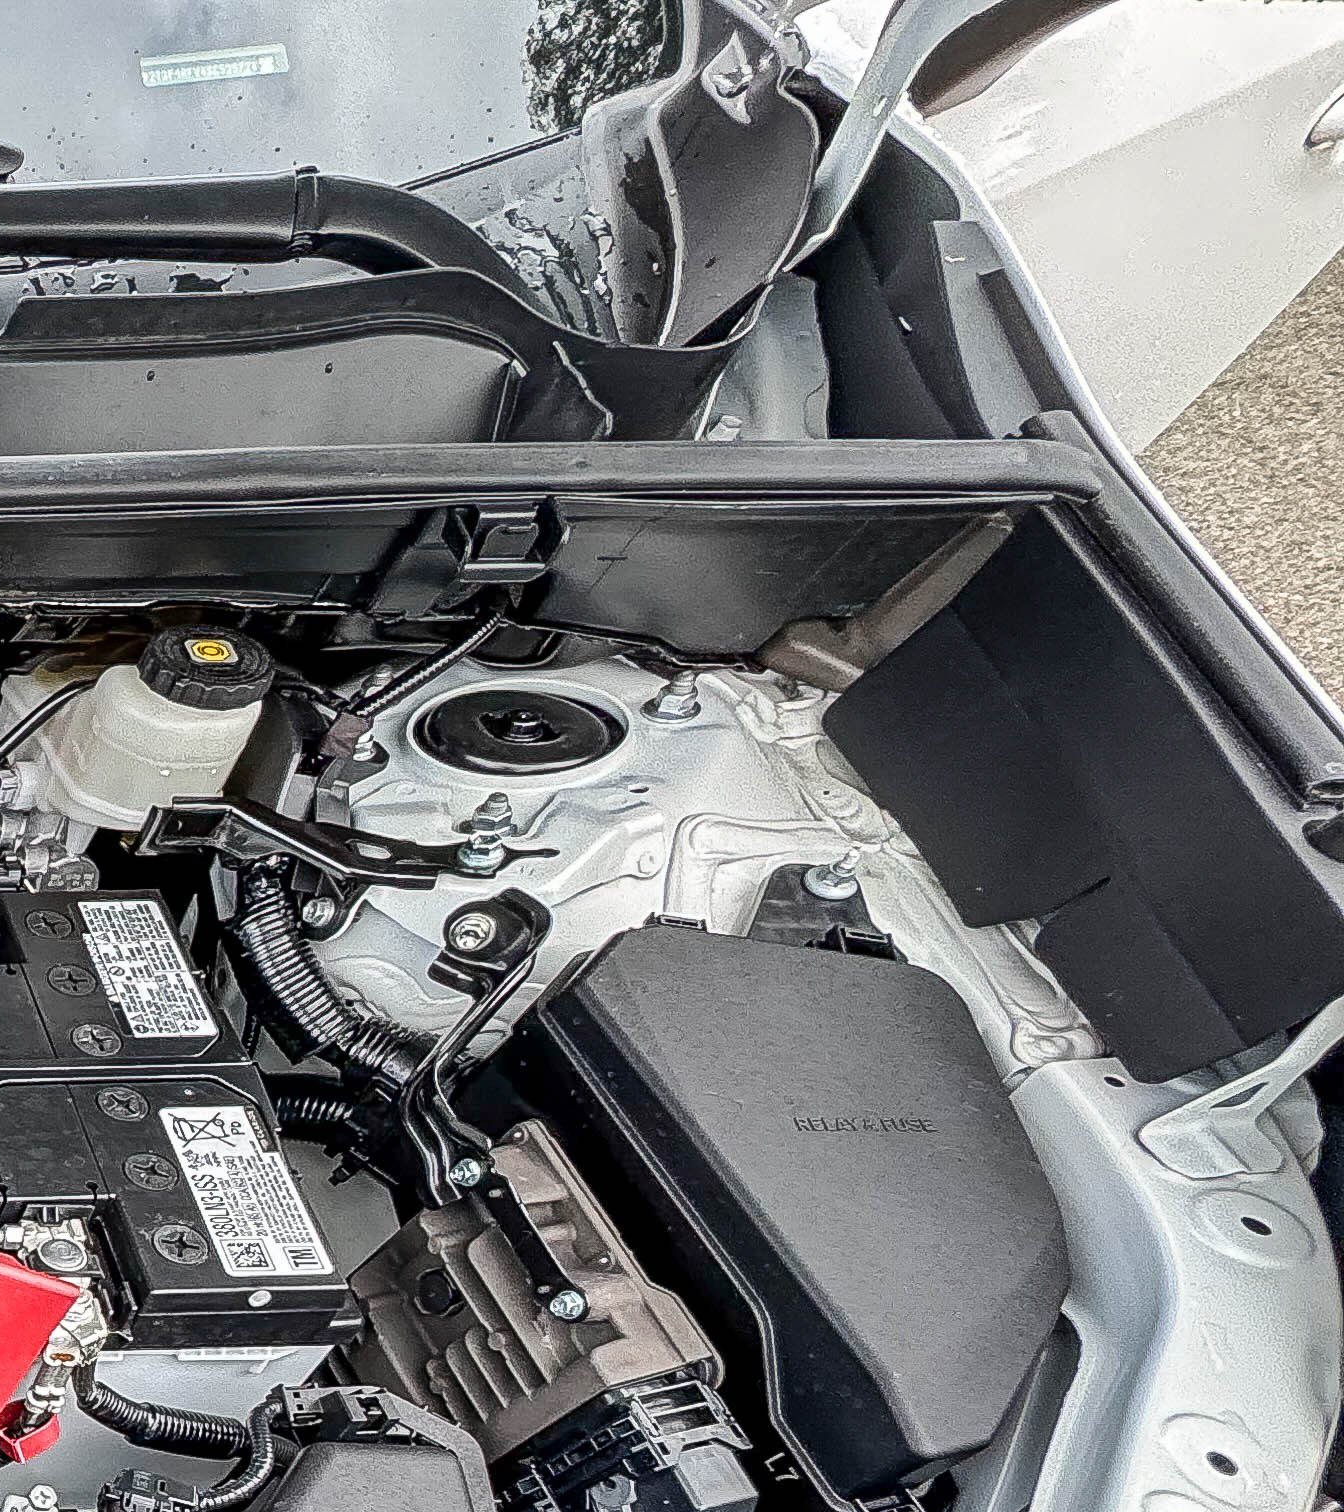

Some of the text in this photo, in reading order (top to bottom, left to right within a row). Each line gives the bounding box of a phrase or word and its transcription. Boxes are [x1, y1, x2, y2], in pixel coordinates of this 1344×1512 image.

[793, 1117, 858, 1132] RELAY
[879, 1117, 939, 1133] FUSE
[288, 1249, 319, 1268] TM
